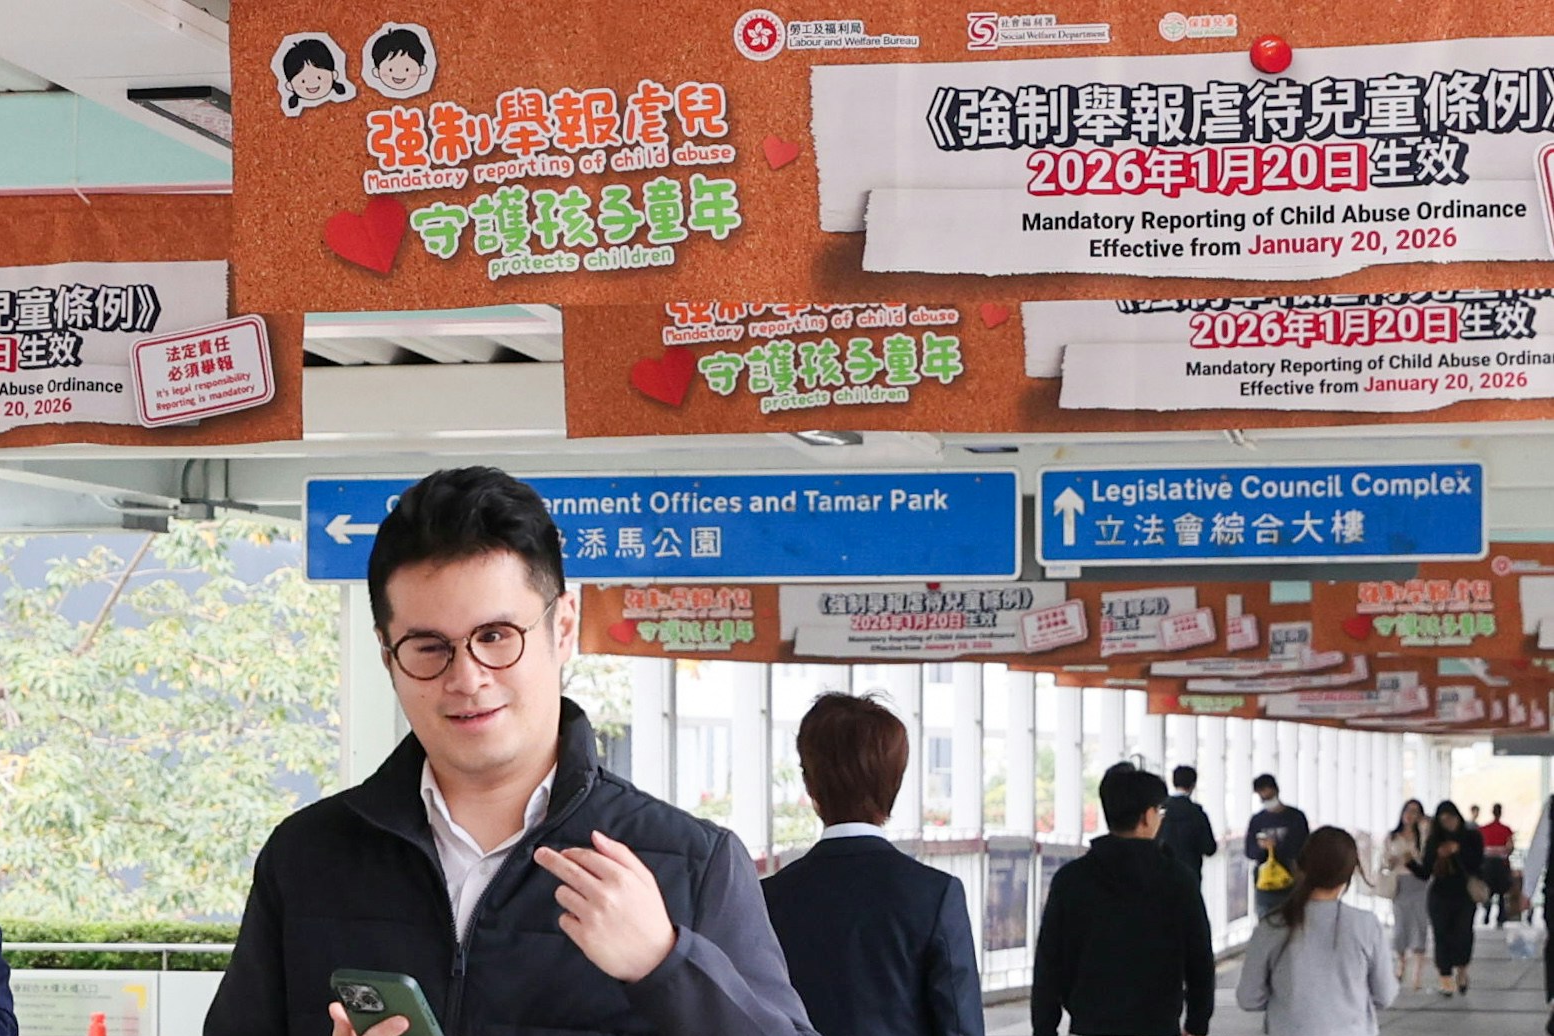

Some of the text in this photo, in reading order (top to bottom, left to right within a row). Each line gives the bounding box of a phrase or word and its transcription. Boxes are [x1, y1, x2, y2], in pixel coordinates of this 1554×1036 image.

[789, 36, 918, 47] Labour and Welfare Bureau
[790, 22, 862, 35] 勞工及福利局
[1000, 29, 1106, 40] Social Welfare Department
[370, 85, 725, 167] 強制舉報虐兒
[368, 146, 731, 190] Mandatory reporting of child abuse
[1026, 135, 1470, 198] 2026年1月20日生效
[414, 177, 738, 254] 守護孩子童年
[1021, 199, 1527, 233] Mandatory Reporting of Child Abuse Ordinance
[1089, 227, 1457, 258] Effective from January 20, 2026
[491, 247, 672, 276] protects children
[665, 325, 742, 342] Mandatory
[750, 316, 825, 336] reporting
[833, 313, 851, 329] of
[856, 309, 904, 327] child
[911, 308, 958, 324] abuse
[1189, 301, 1537, 350] 2026年1月20日生效
[166, 335, 230, 362] 法定責任
[168, 355, 234, 382] 必須舉報
[699, 335, 962, 393] 守護孩子童年
[1185, 349, 1554, 378] Mandatory Reporting of Child Abuse Ordina
[0, 379, 44, 395] Abuse
[47, 376, 123, 393] Ordinance
[156, 384, 255, 411] Reporting is mandatory
[172, 383, 192, 396] legal
[195, 372, 251, 391] responsibility
[762, 386, 908, 411] protects children
[1240, 371, 1528, 397] Effective from January 20, 2026
[4, 400, 29, 419] 20,
[34, 398, 72, 415] 2026
[543, 488, 948, 515] ernment Offices and Tamar Park
[1092, 471, 1472, 506] Legislative Council Complex
[1094, 509, 1366, 546] 立法會綜合大樓
